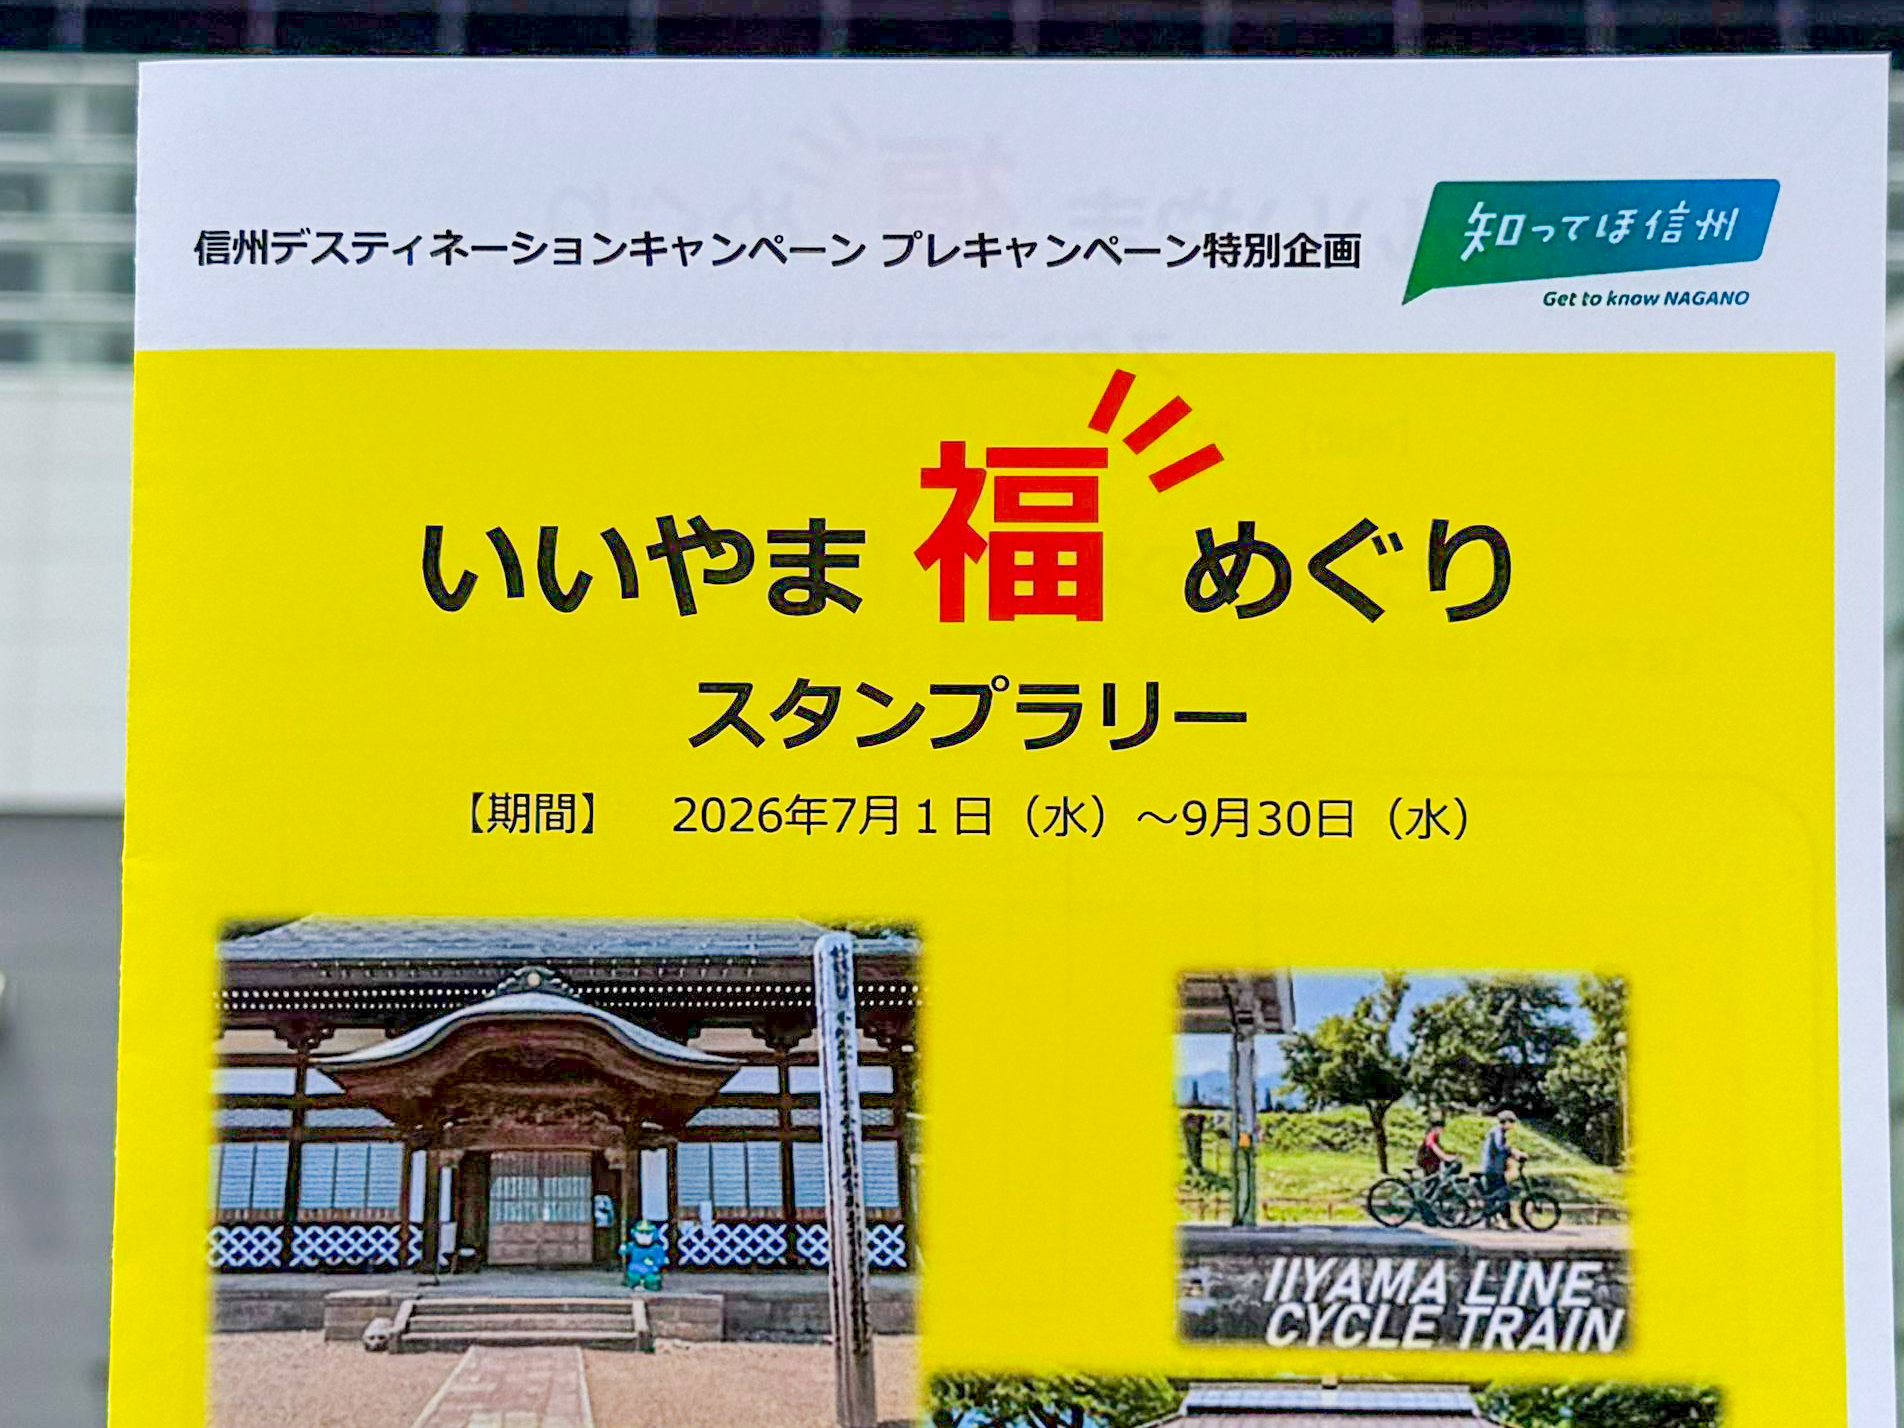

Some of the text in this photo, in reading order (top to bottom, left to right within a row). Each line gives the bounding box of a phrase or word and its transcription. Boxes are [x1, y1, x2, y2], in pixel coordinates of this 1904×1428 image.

[194, 227, 1362, 269] 信州デスティネーションキャンペーン プレキャンペーン特別企画
[1460, 200, 1740, 262] 知ってほ信州
[1543, 290, 1750, 307] Get to know NAGANO
[421, 440, 1513, 625] いいやま 福 めぐり
[688, 672, 1249, 753] スタンプラリー
[469, 791, 597, 837] 【期間】
[1263, 1257, 1604, 1308] IIYAMA LINE
[1265, 1303, 1625, 1353] CYCLE TRAIN
